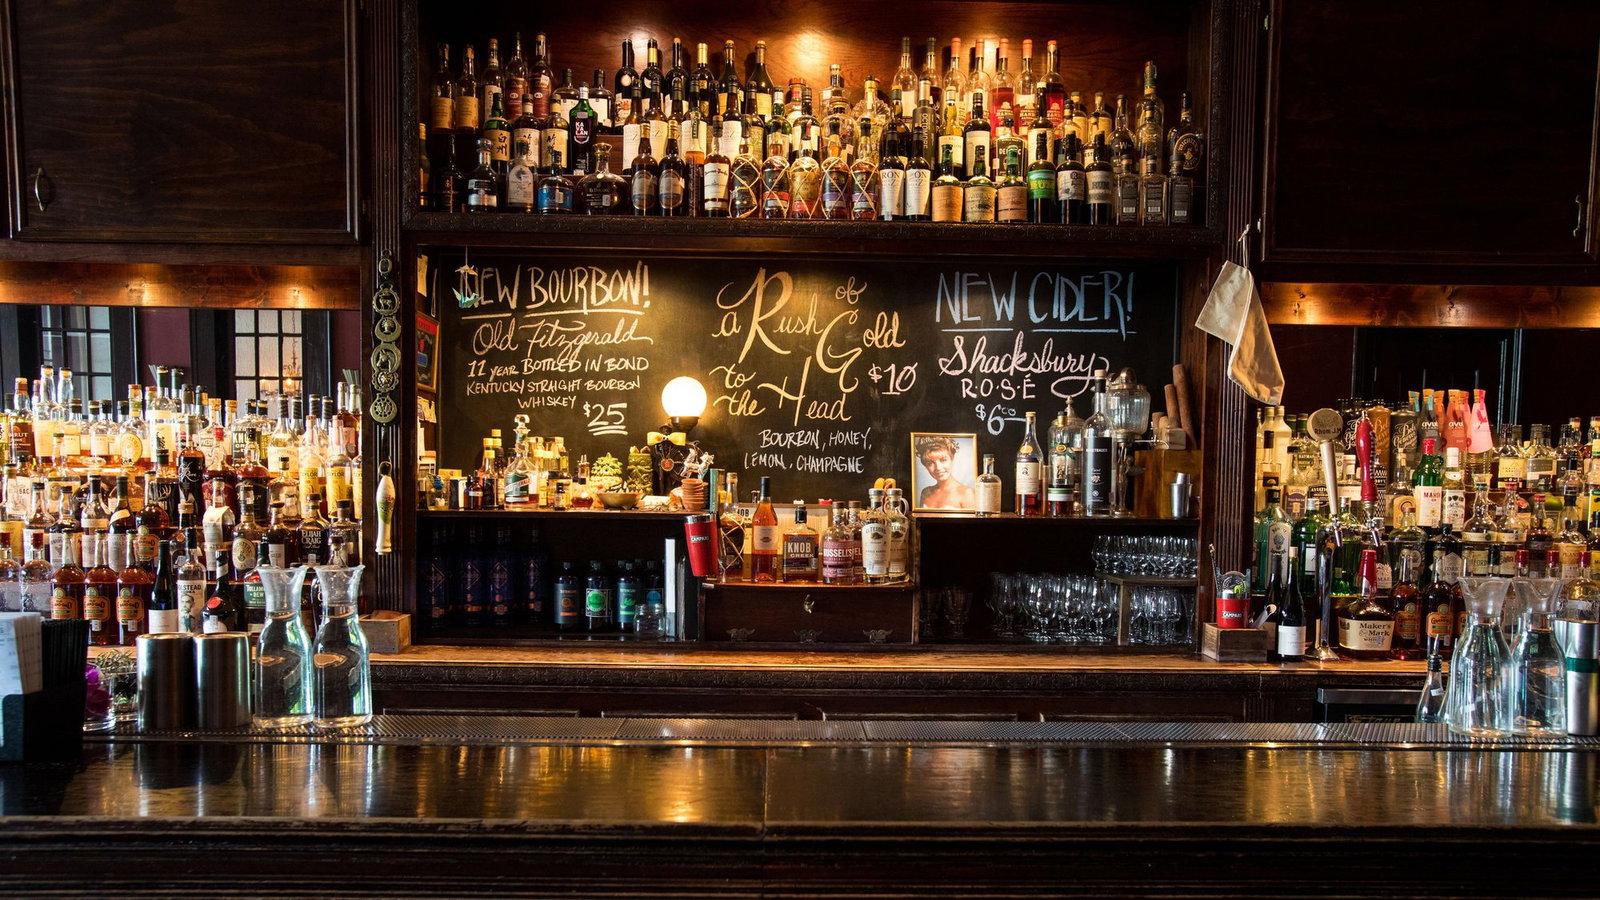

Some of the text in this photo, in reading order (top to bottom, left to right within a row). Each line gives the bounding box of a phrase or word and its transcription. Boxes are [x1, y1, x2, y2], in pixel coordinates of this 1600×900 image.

[459, 260, 650, 315] NEW BOURBON!
[936, 271, 1134, 341] NEW CIDER!
[473, 316, 654, 363] Old Fitzgerald
[711, 267, 906, 393] a Rush of Gold
[489, 364, 519, 381] YEAR
[521, 357, 581, 375] BOTTLED
[585, 354, 602, 372] IN
[606, 356, 649, 372] BOND
[708, 363, 756, 389] to
[939, 331, 1110, 398] Shacksbury
[466, 375, 641, 396] KENTUCKY STRAIGHT BOURBON
[713, 355, 852, 426] the Head
[867, 362, 919, 395] $10
[517, 396, 577, 409] WHISKEY
[583, 401, 627, 427] $25
[758, 427, 872, 451] BOURBON, HONEY,
[744, 452, 865, 474] LEMON, CHAMPAGNE
[301, 537, 321, 545] CRAIG
[787, 542, 812, 553] KNOB
